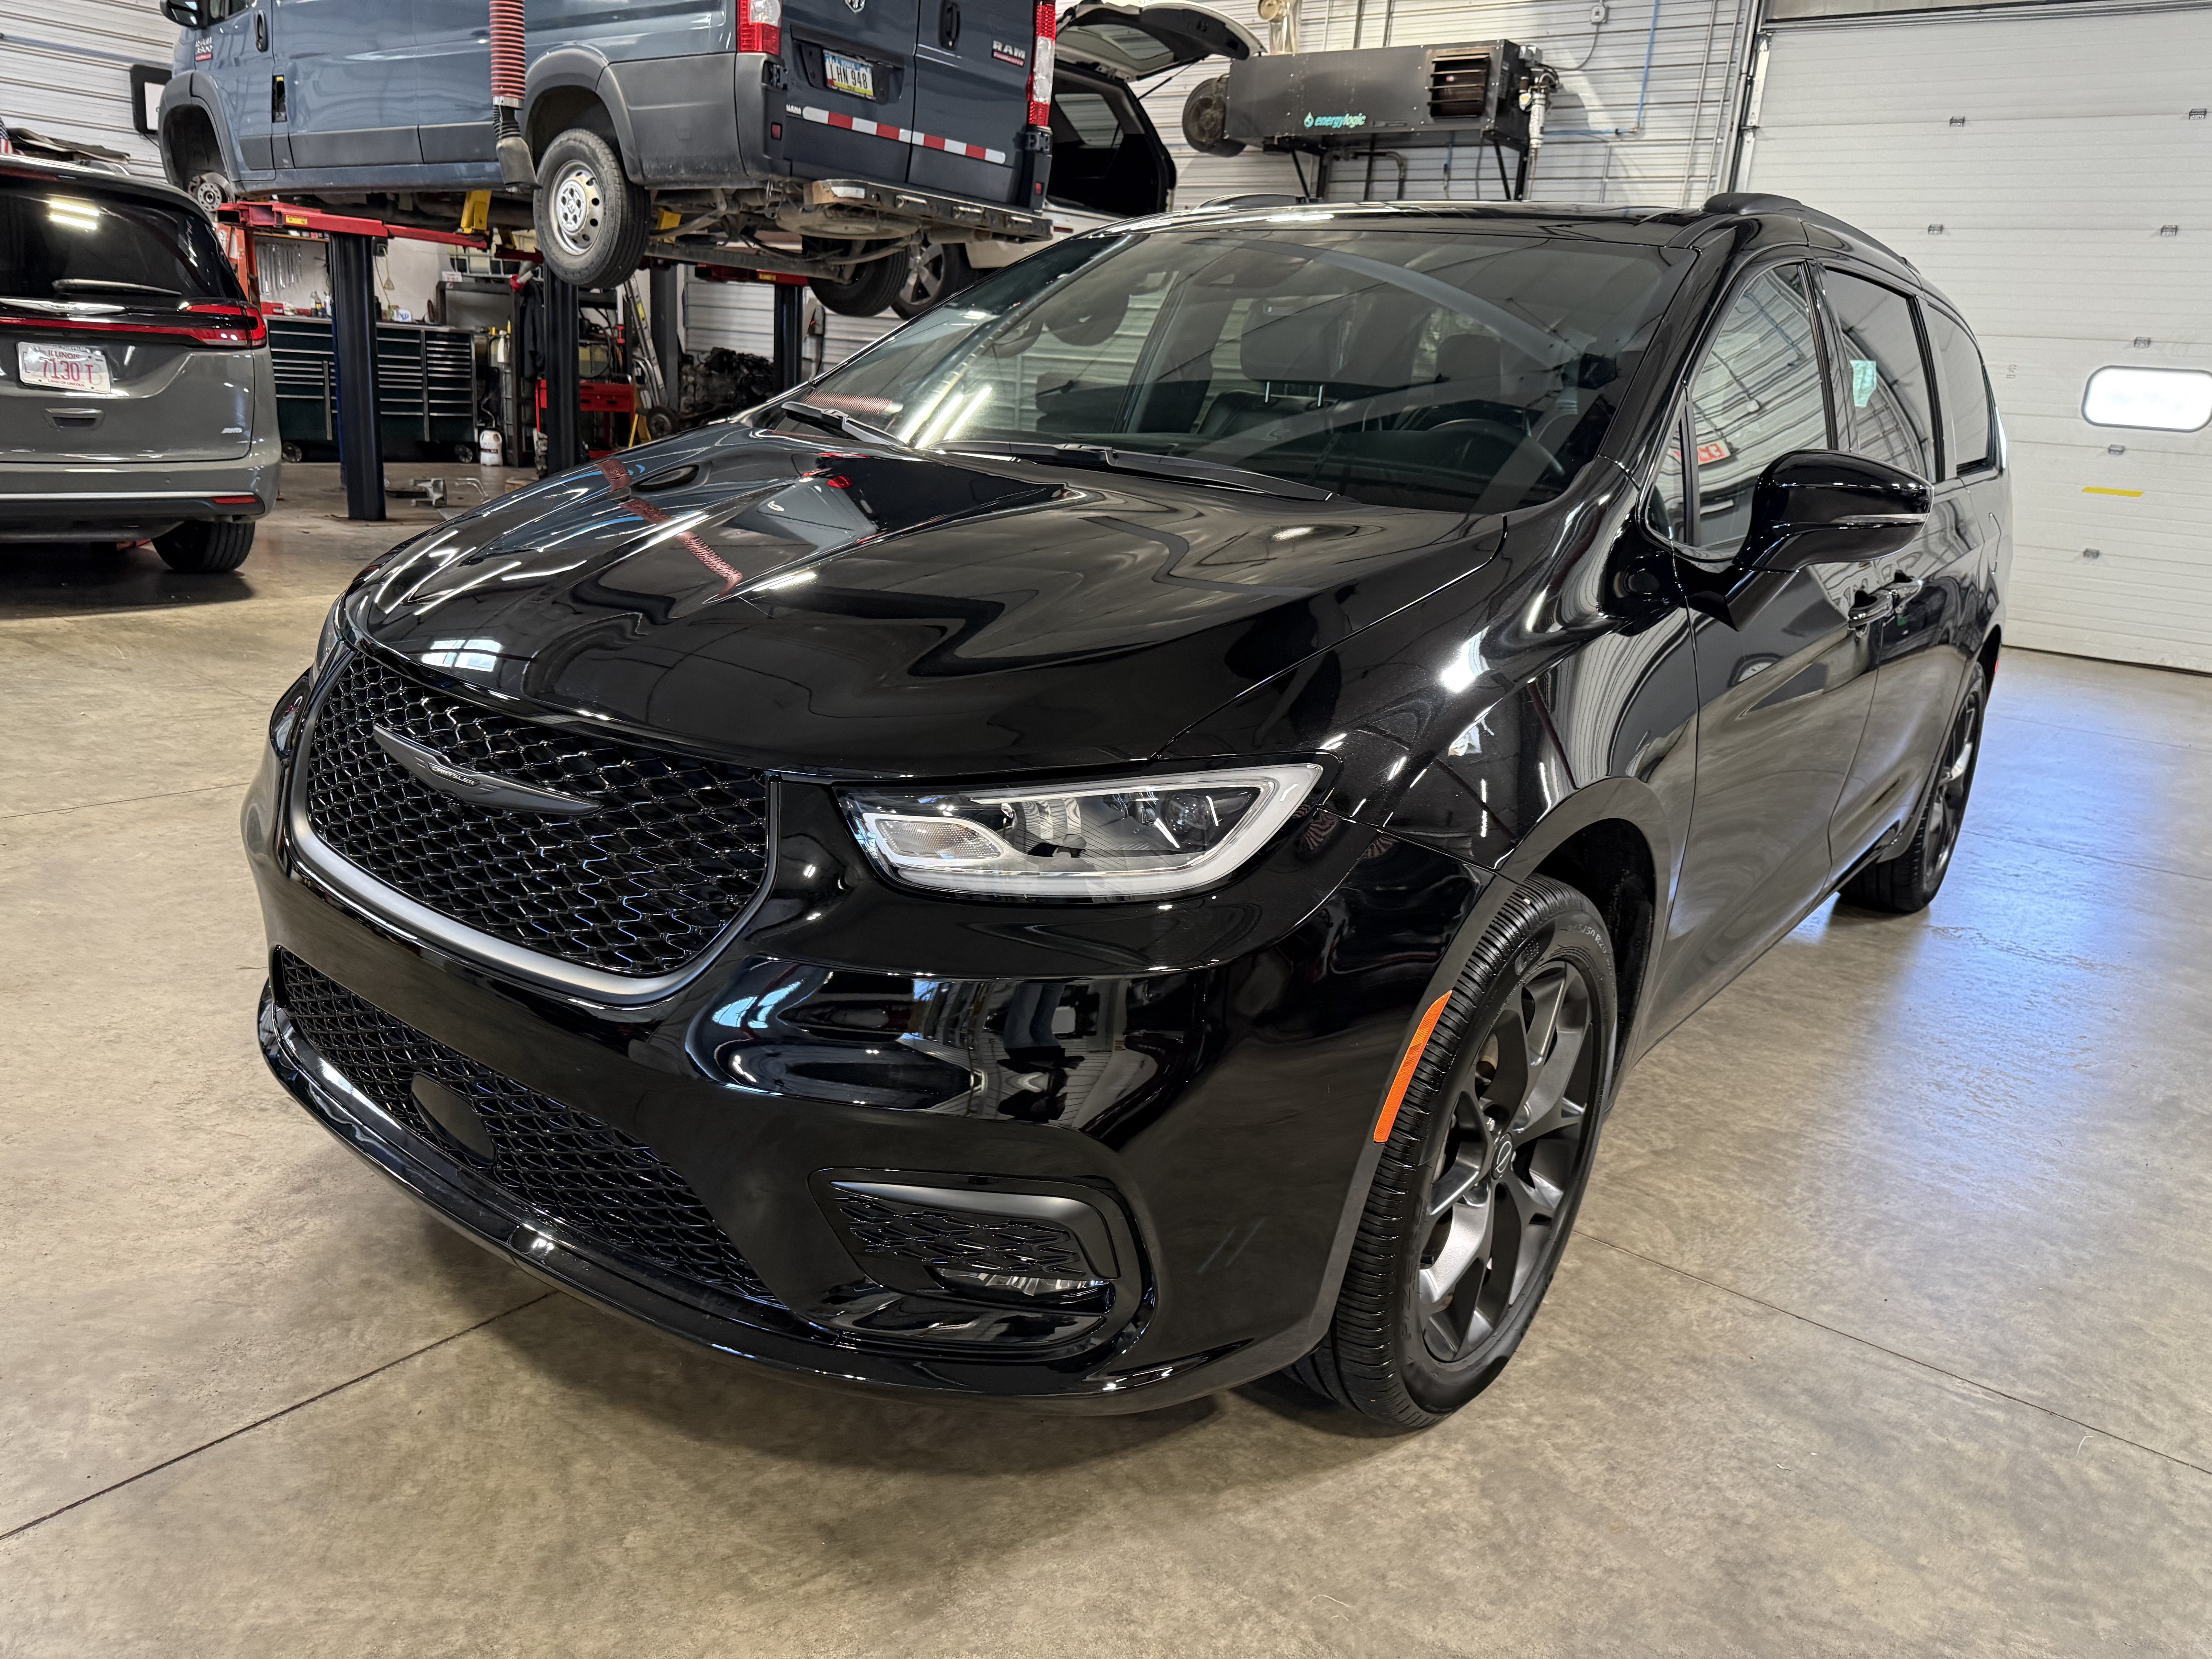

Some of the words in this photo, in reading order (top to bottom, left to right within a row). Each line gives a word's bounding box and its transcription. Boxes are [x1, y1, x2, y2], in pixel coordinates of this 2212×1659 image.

[993, 40, 1025, 59] RAM
[830, 64, 849, 84] LHN
[852, 70, 867, 89] 948
[1314, 113, 1367, 129] energylogic
[48, 350, 80, 359] ILLINOIS
[39, 356, 80, 381] 7130
[85, 364, 93, 384] T
[432, 766, 475, 785] CHRYSLER
